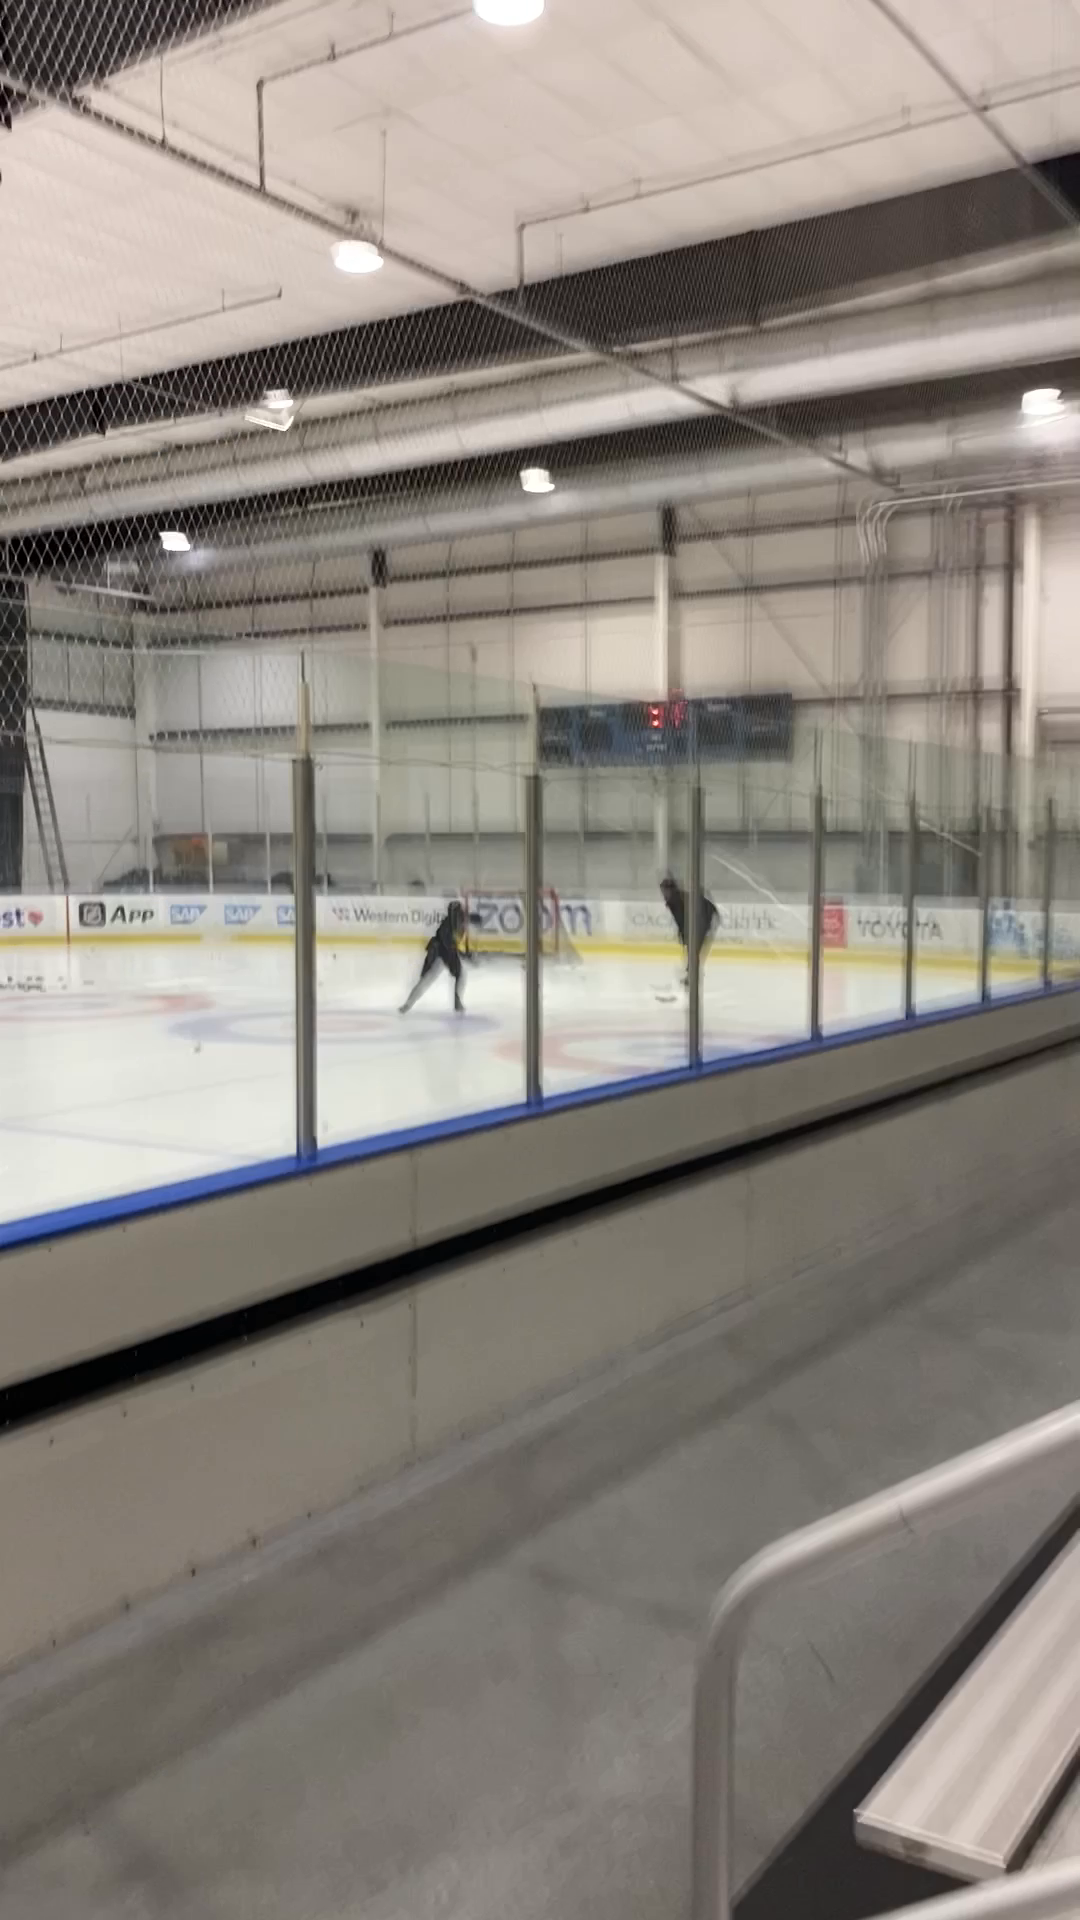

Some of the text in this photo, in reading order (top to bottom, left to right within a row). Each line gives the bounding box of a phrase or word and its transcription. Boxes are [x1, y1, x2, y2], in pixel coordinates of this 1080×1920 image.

[0, 907, 25, 928] st
[171, 905, 203, 923] SAP
[225, 905, 257, 923] SAP
[277, 905, 296, 923] SA
[353, 907, 409, 923] Western
